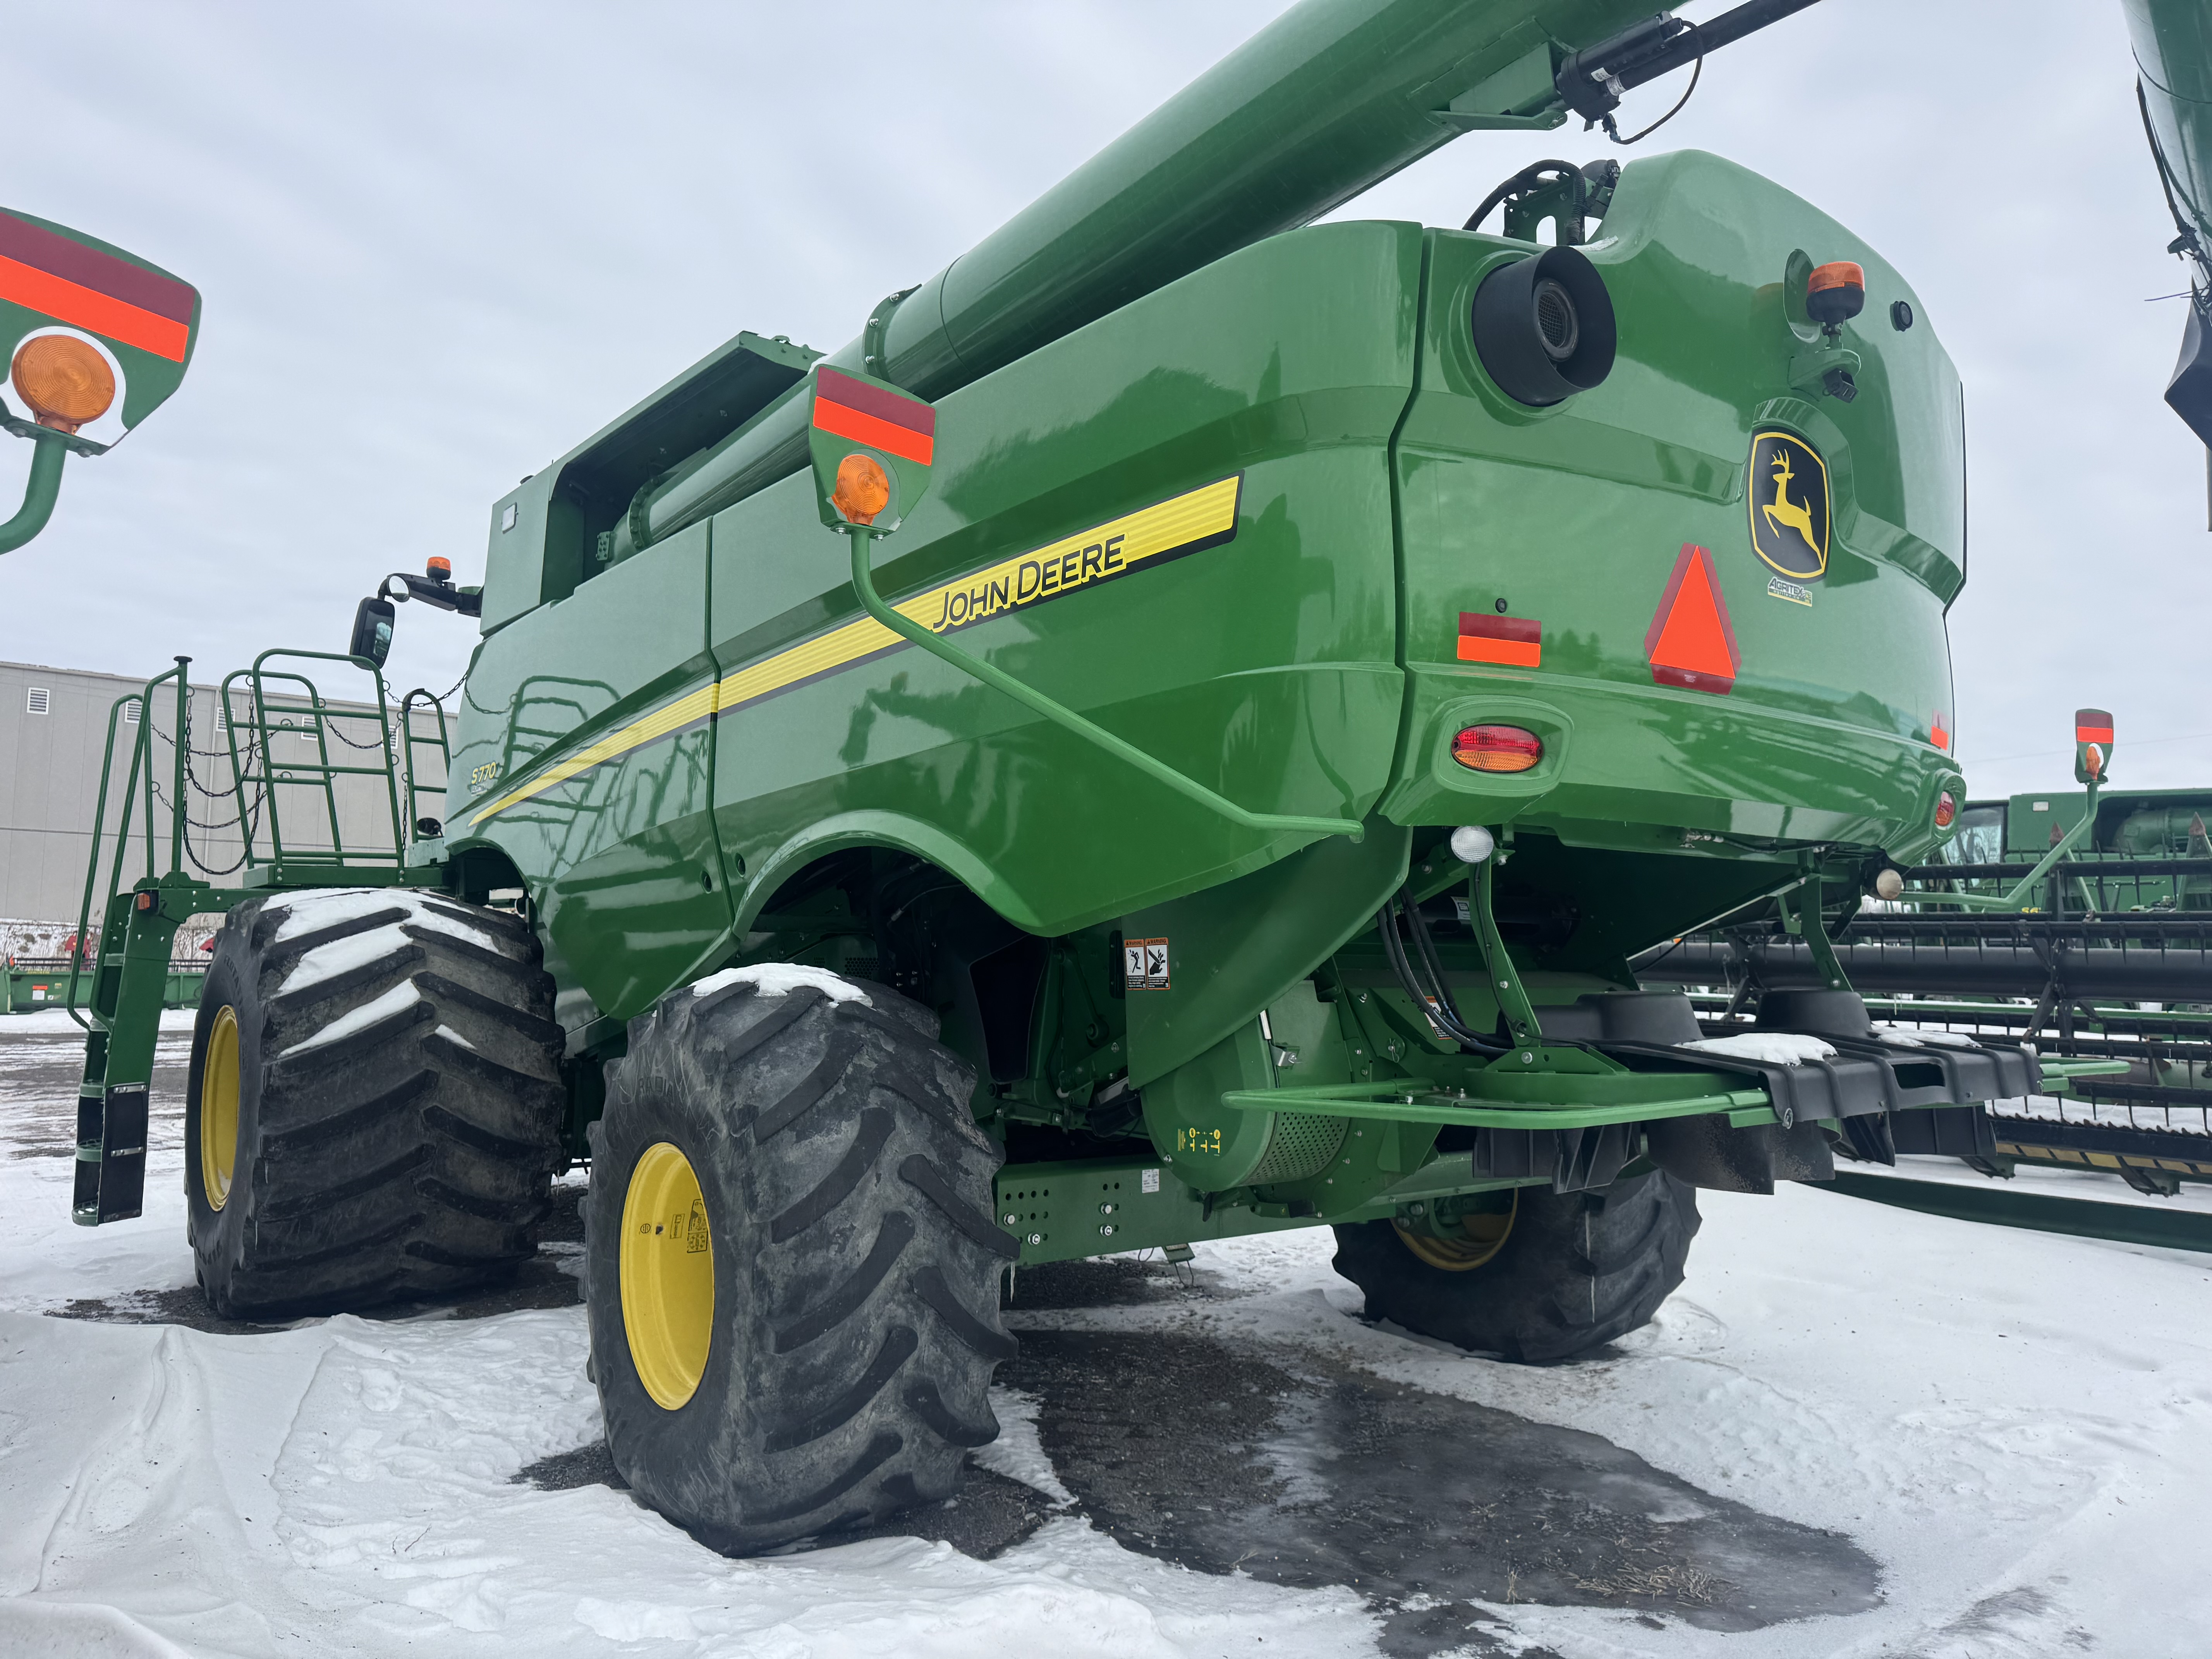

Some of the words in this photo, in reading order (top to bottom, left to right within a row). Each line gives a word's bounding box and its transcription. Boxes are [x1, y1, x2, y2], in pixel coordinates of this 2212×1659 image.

[933, 576, 1010, 629] JOHN
[1017, 533, 1125, 600] DEERE
[1769, 578, 1803, 596] AGRITEX
[471, 761, 496, 785] S770
